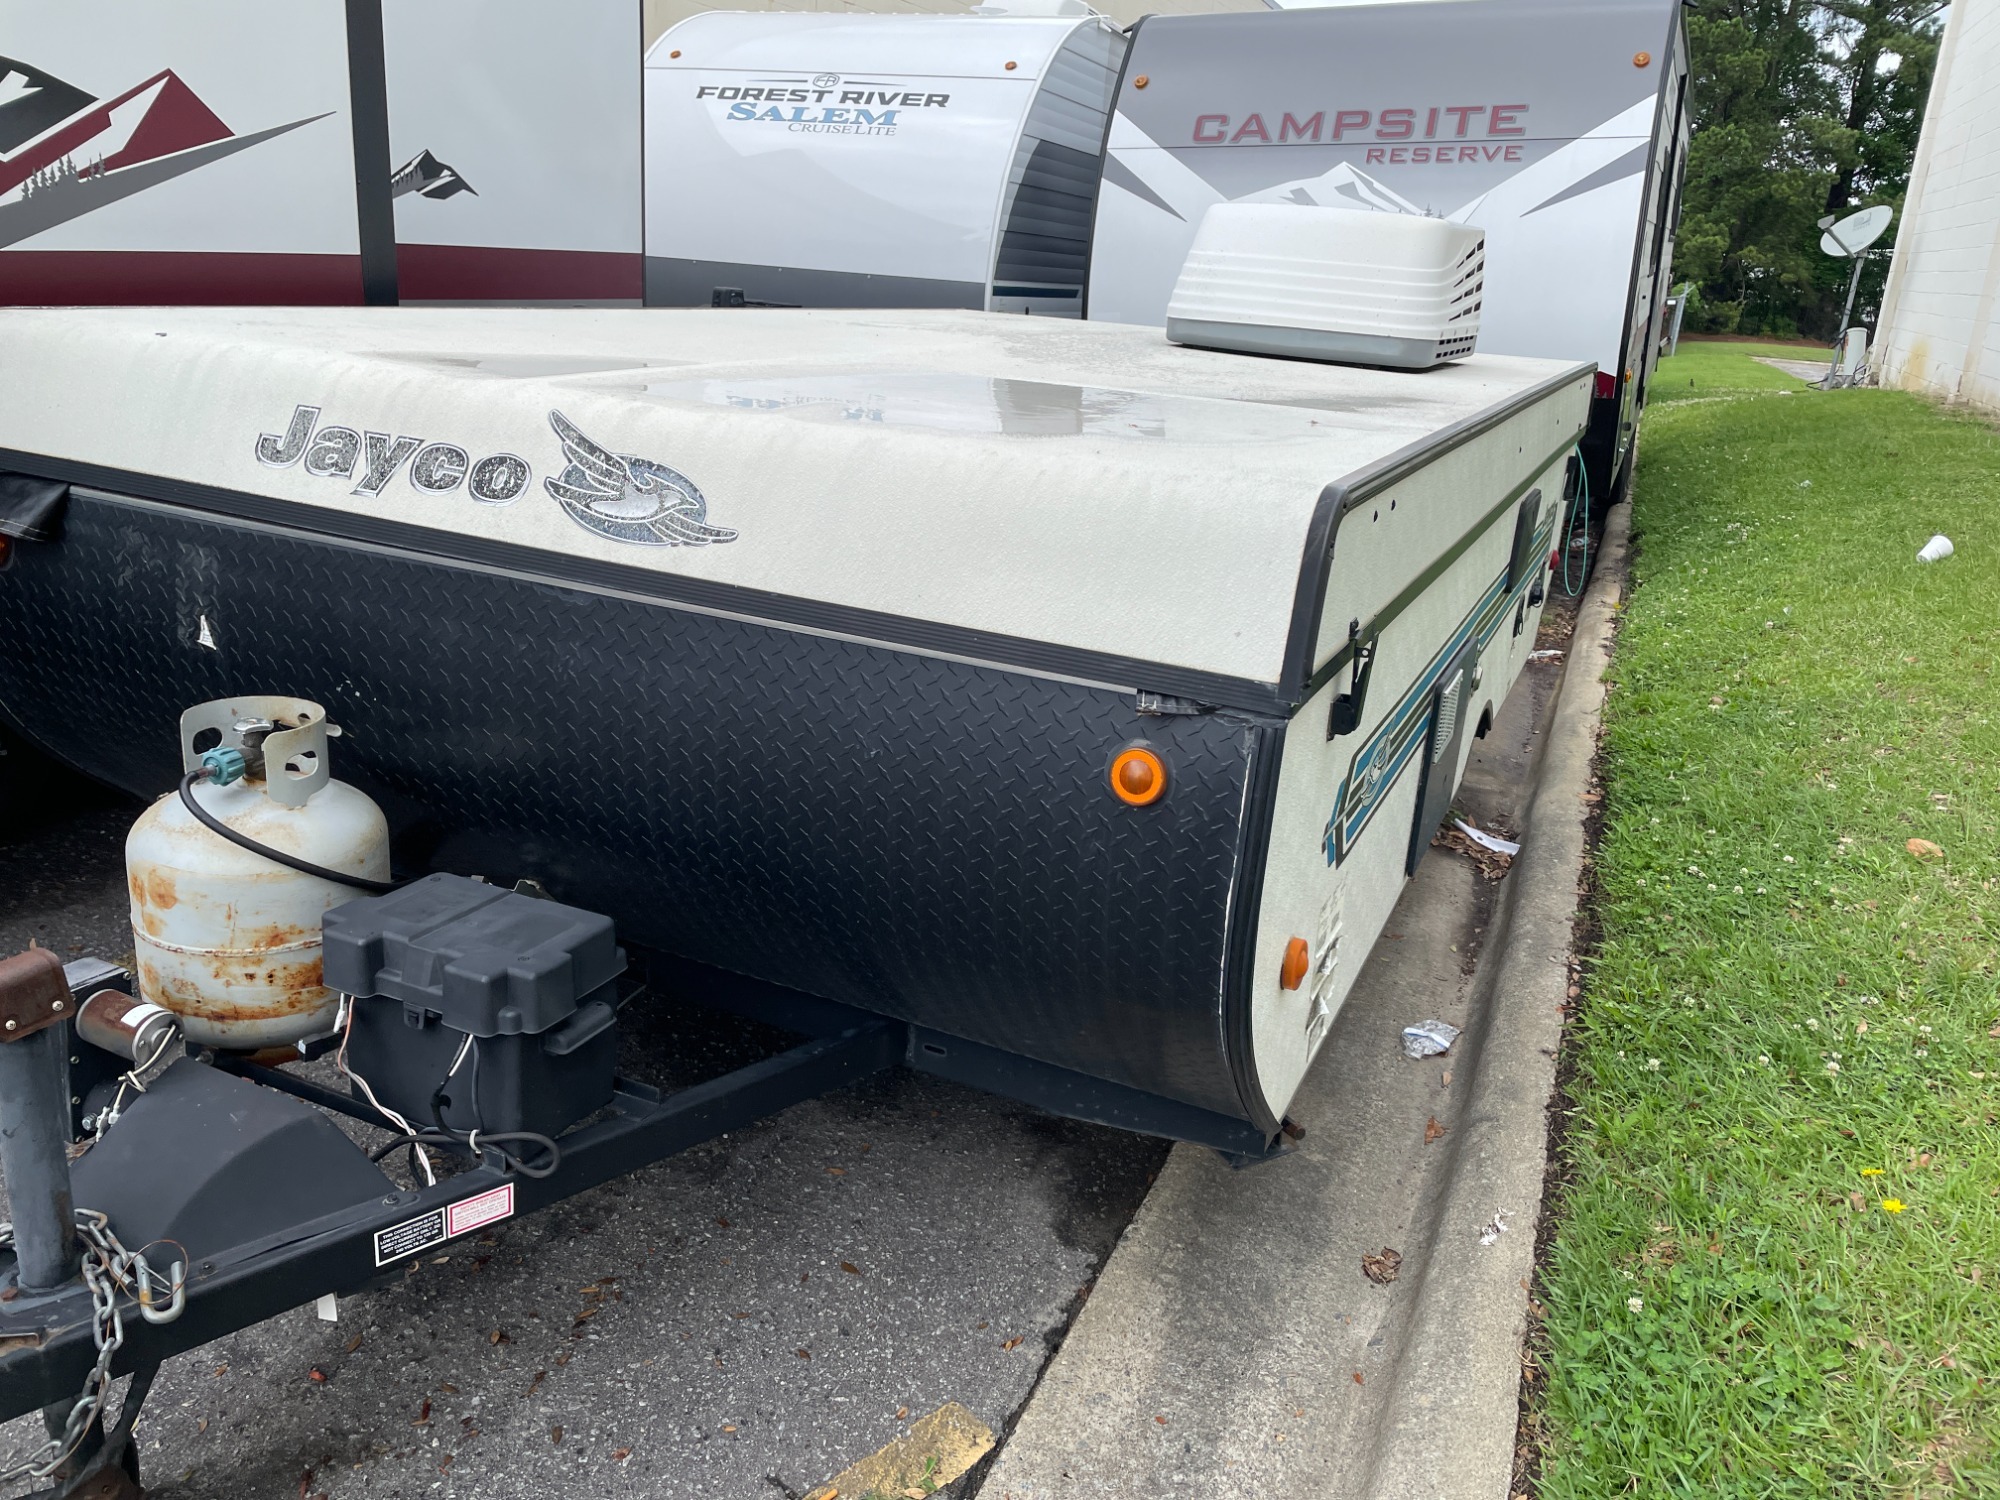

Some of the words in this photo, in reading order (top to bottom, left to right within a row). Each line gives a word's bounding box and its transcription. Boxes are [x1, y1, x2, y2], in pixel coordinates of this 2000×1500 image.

[814, 74, 840, 87] FR
[696, 86, 834, 103] FOREST
[839, 90, 951, 107] RIVER
[726, 102, 901, 126] SALEM
[1192, 103, 1530, 146] CAMPSITE
[1365, 144, 1524, 166] RESERVE
[255, 404, 533, 507] Jayco
[393, 1221, 424, 1236] CONNECTION
[394, 1238, 416, 1250] CONNECT
